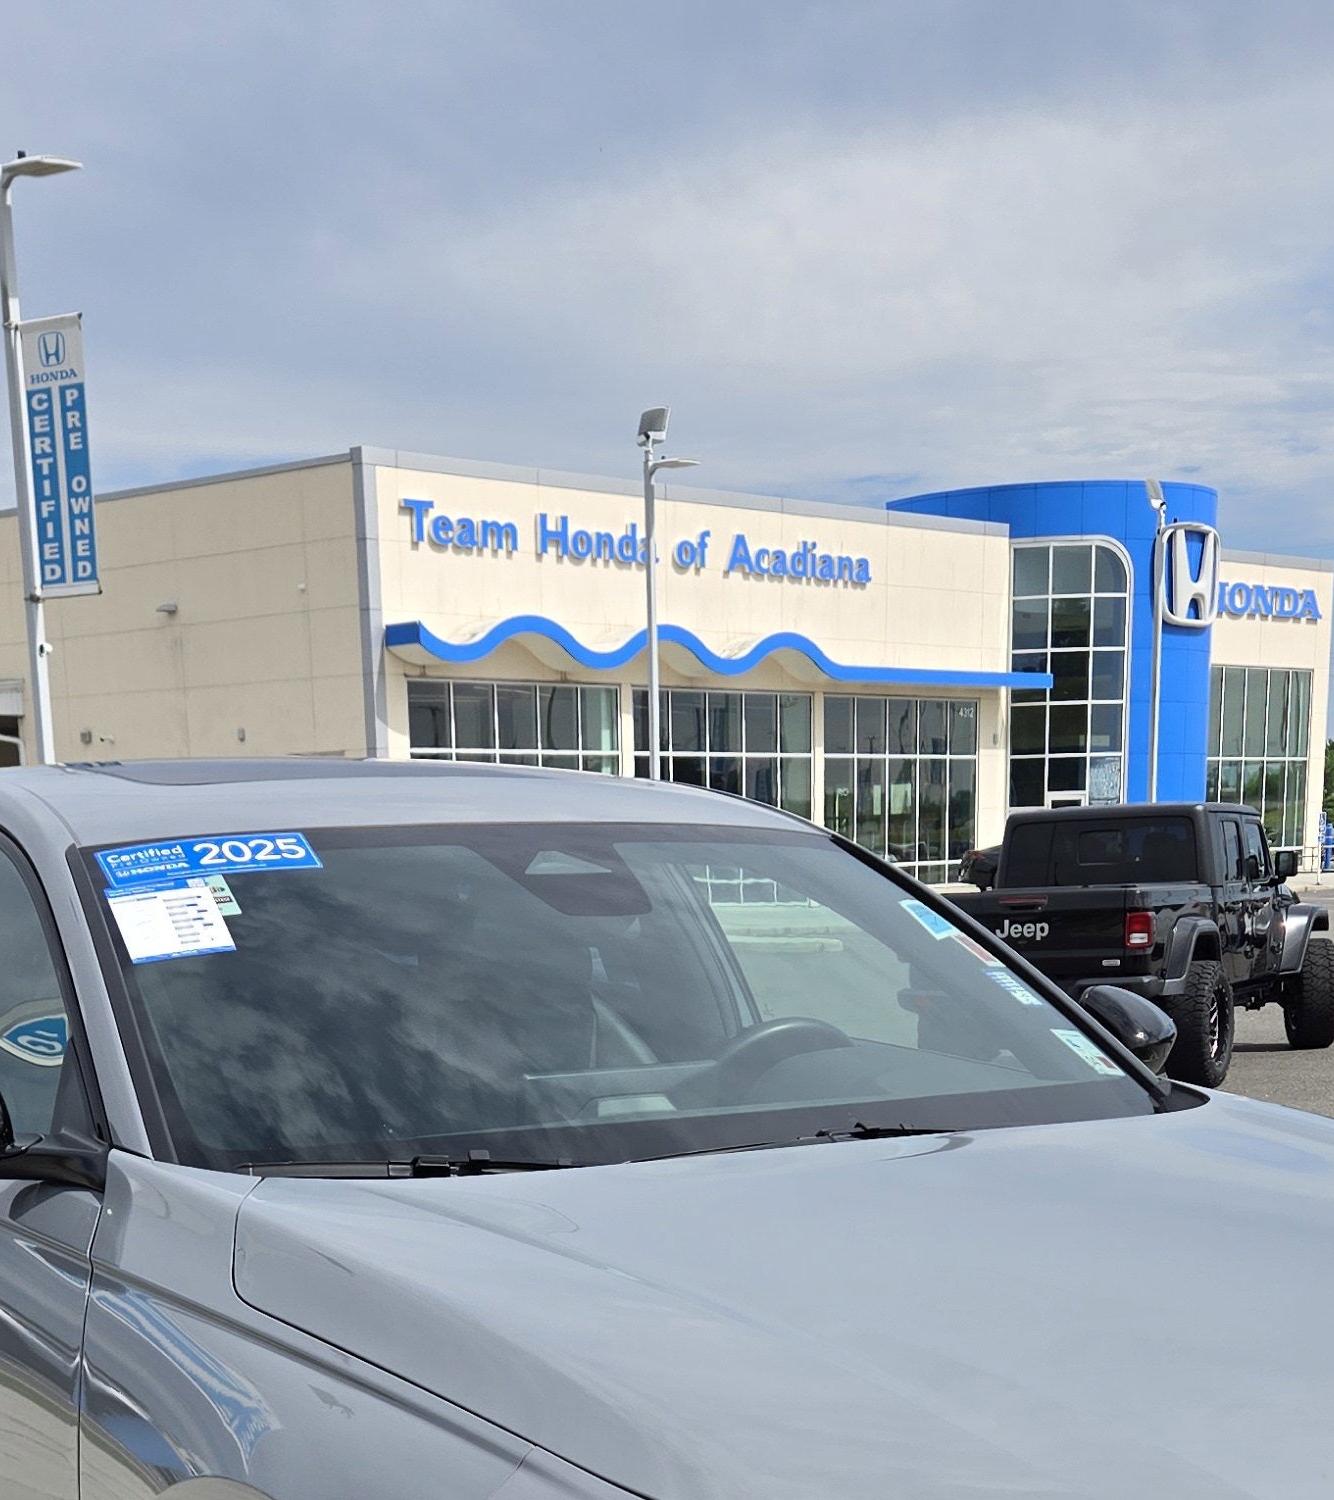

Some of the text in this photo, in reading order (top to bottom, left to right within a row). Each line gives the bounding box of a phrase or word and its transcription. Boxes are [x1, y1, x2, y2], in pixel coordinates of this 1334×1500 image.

[30, 368, 78, 385] HONDA
[30, 392, 63, 583] CERTIFIED
[64, 388, 93, 579] PRE OWNED
[398, 498, 519, 552] Team
[673, 530, 712, 570] of
[727, 534, 872, 584] Acadiana
[106, 844, 186, 864] Certified
[192, 837, 307, 866] 2025
[995, 919, 1050, 941] Jeep
